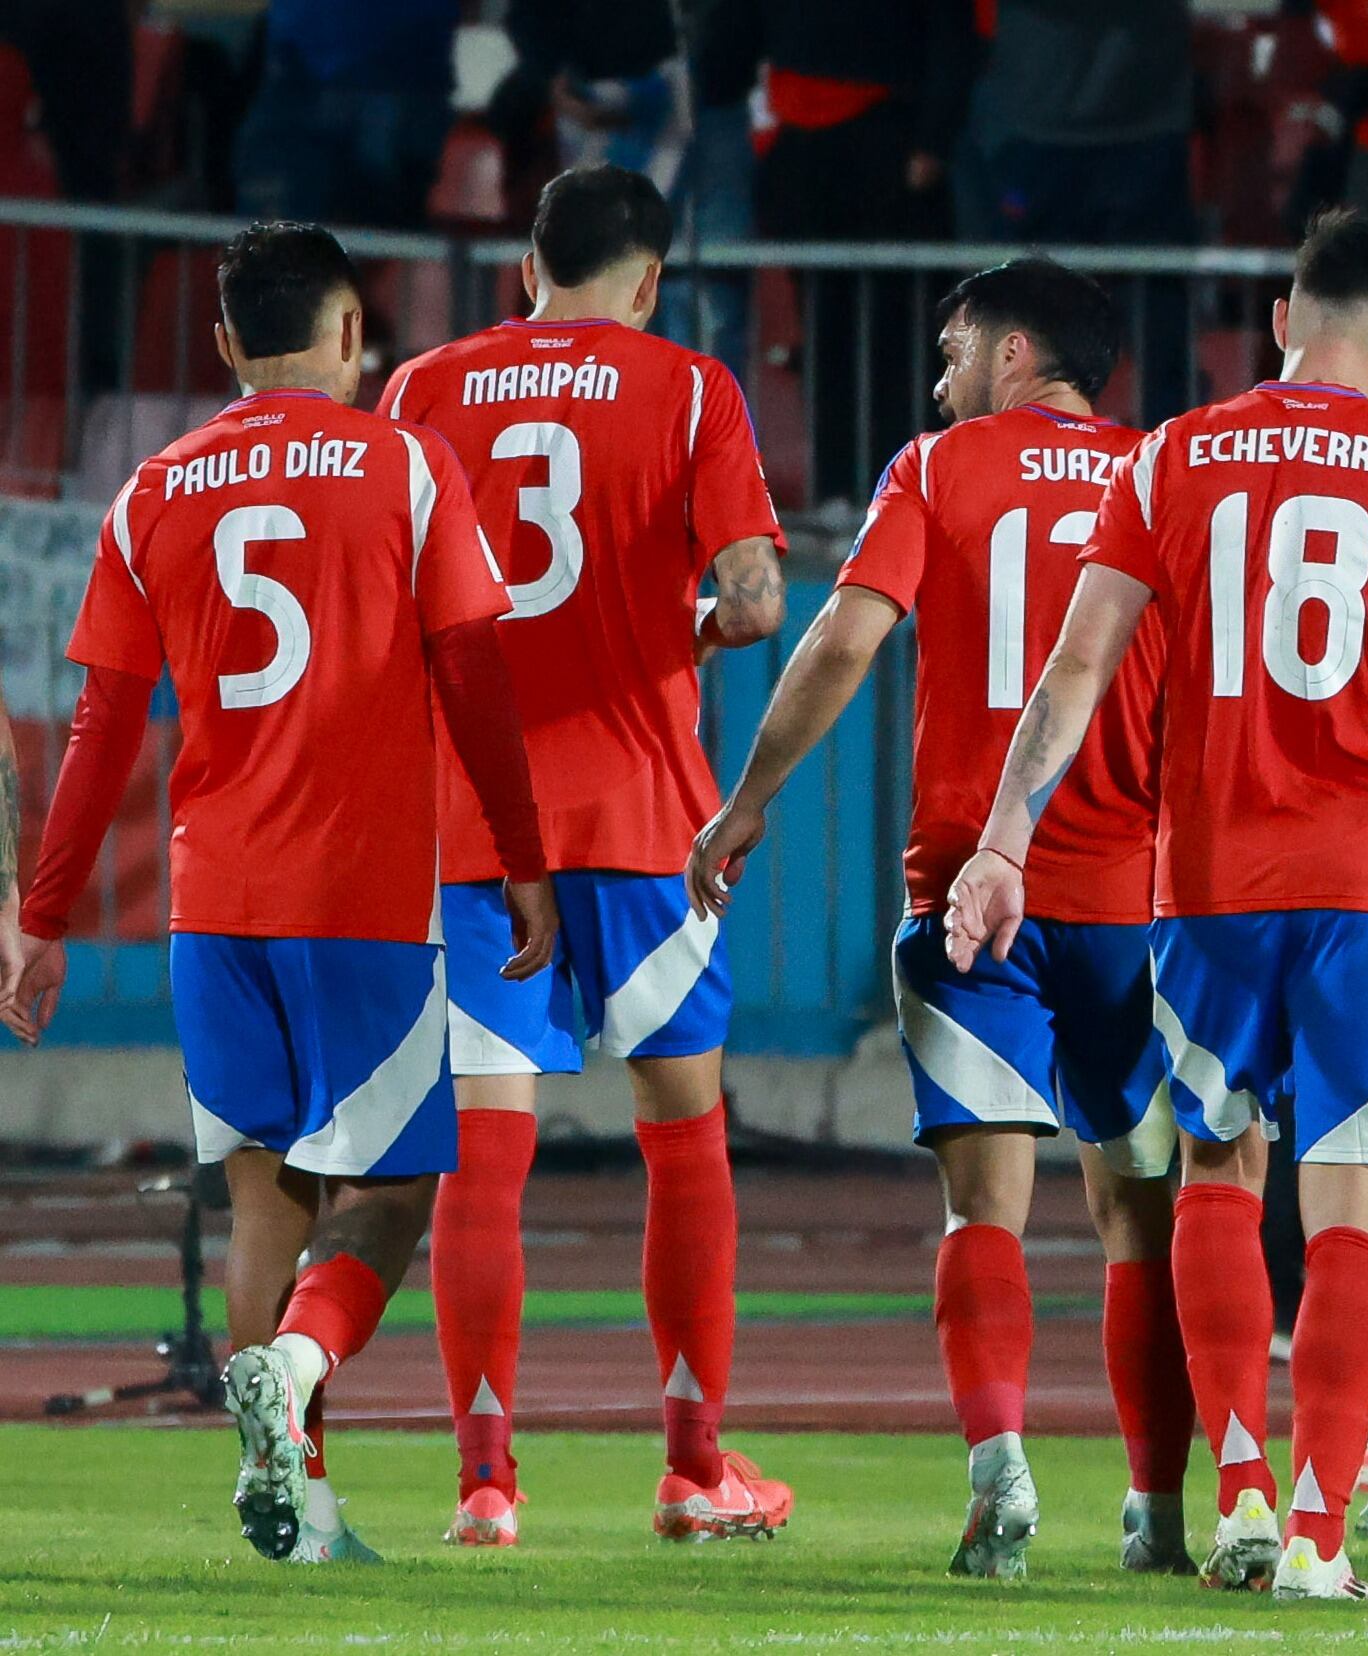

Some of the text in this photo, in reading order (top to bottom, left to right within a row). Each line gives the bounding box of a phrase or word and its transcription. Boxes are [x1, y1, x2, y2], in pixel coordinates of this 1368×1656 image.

[165, 431, 368, 501] PAULO DÍAZ
[463, 355, 619, 406] MARIPÁN
[213, 504, 311, 710] 5
[491, 421, 584, 621] 3
[987, 507, 1098, 709] 1
